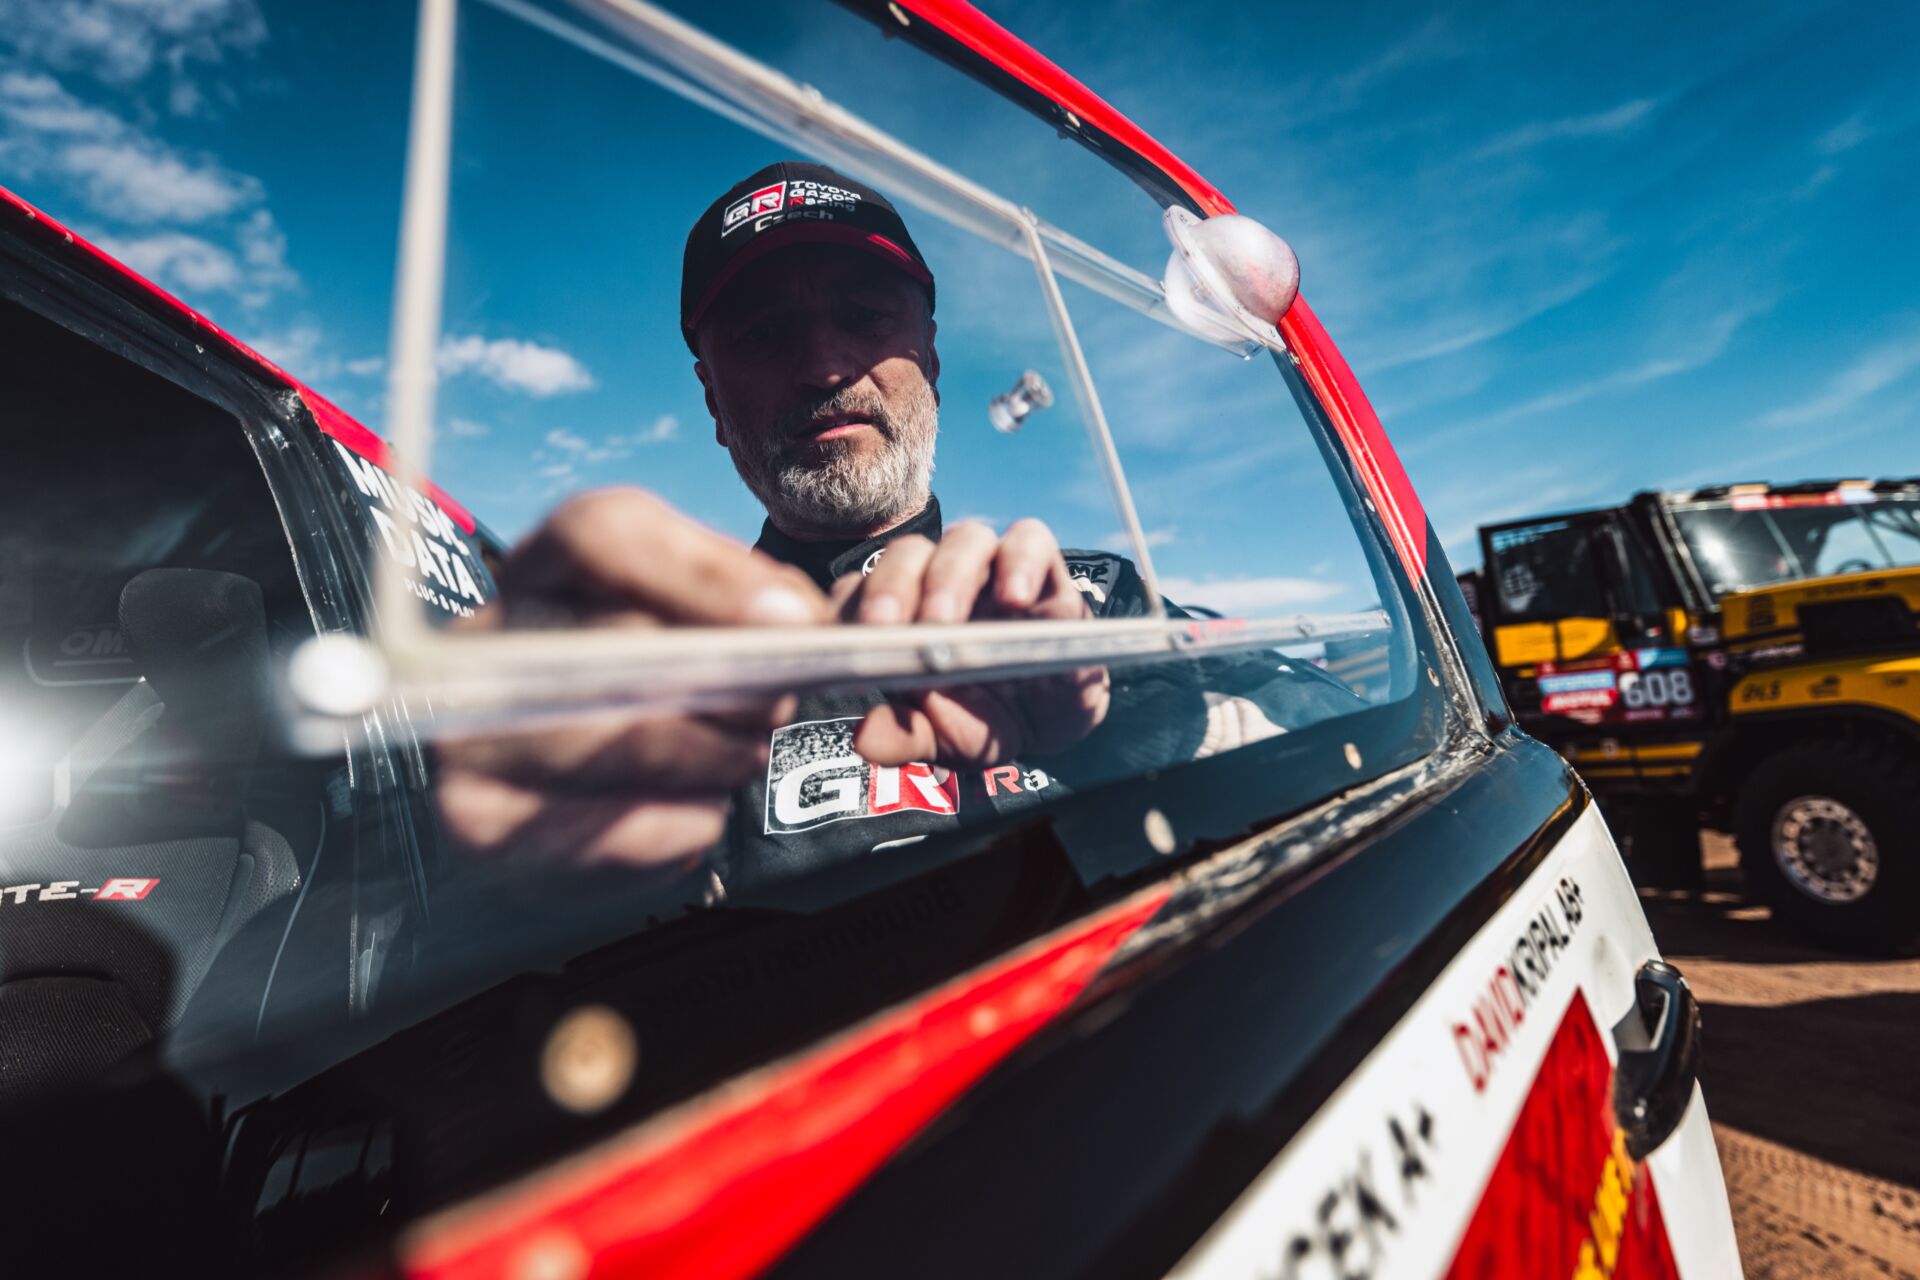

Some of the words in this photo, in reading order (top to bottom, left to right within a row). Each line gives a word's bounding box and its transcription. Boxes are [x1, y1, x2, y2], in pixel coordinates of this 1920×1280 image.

[789, 180, 862, 201] TOYOTA
[789, 188, 857, 205] GAZOO
[724, 191, 781, 227] GR
[788, 196, 856, 212] Racing
[754, 209, 834, 233] Czech
[369, 505, 485, 605] DATA
[59, 630, 130, 656] OM
[1621, 670, 1694, 708] 608
[775, 758, 953, 825] GR
[984, 766, 1057, 797] Ra
[0, 879, 152, 905] TE-R
